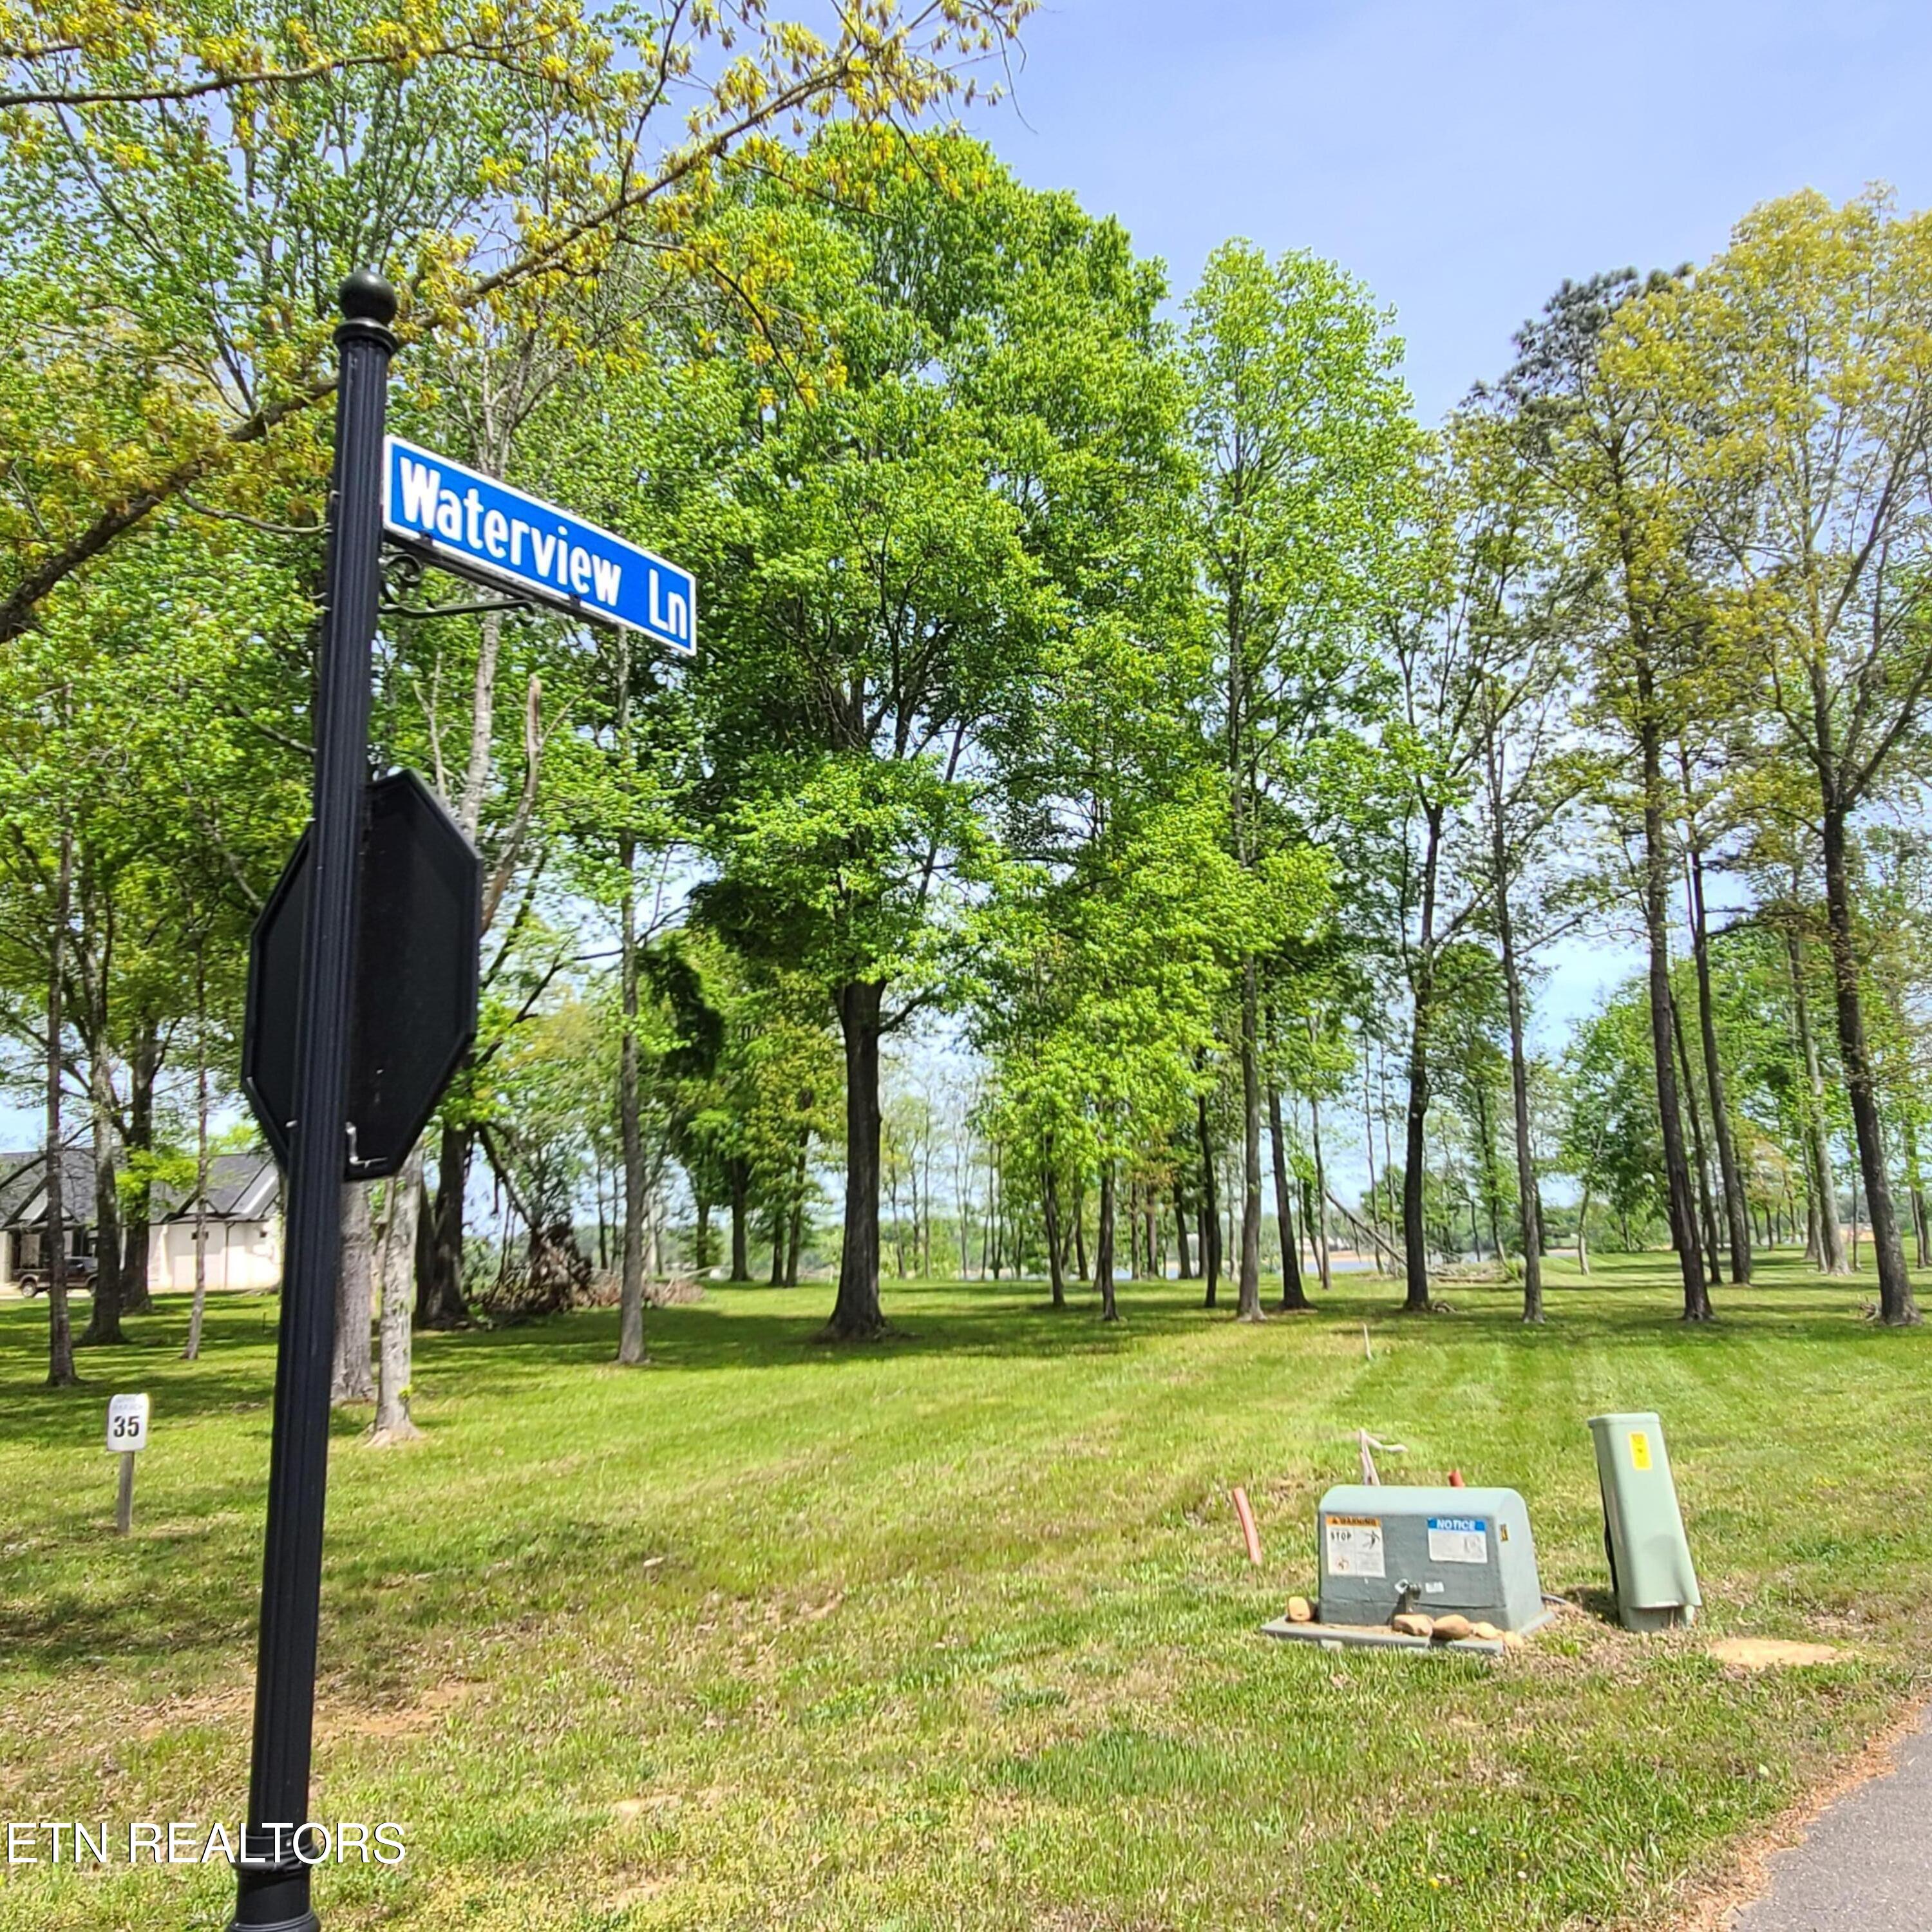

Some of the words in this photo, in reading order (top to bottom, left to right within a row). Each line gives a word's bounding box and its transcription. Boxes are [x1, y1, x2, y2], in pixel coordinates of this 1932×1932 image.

[399, 456, 621, 607] Waterview
[649, 568, 688, 639] Ln
[113, 1416, 140, 1437] 35
[1436, 1519, 1475, 1531] NOTICE
[1331, 1531, 1352, 1541] STOP
